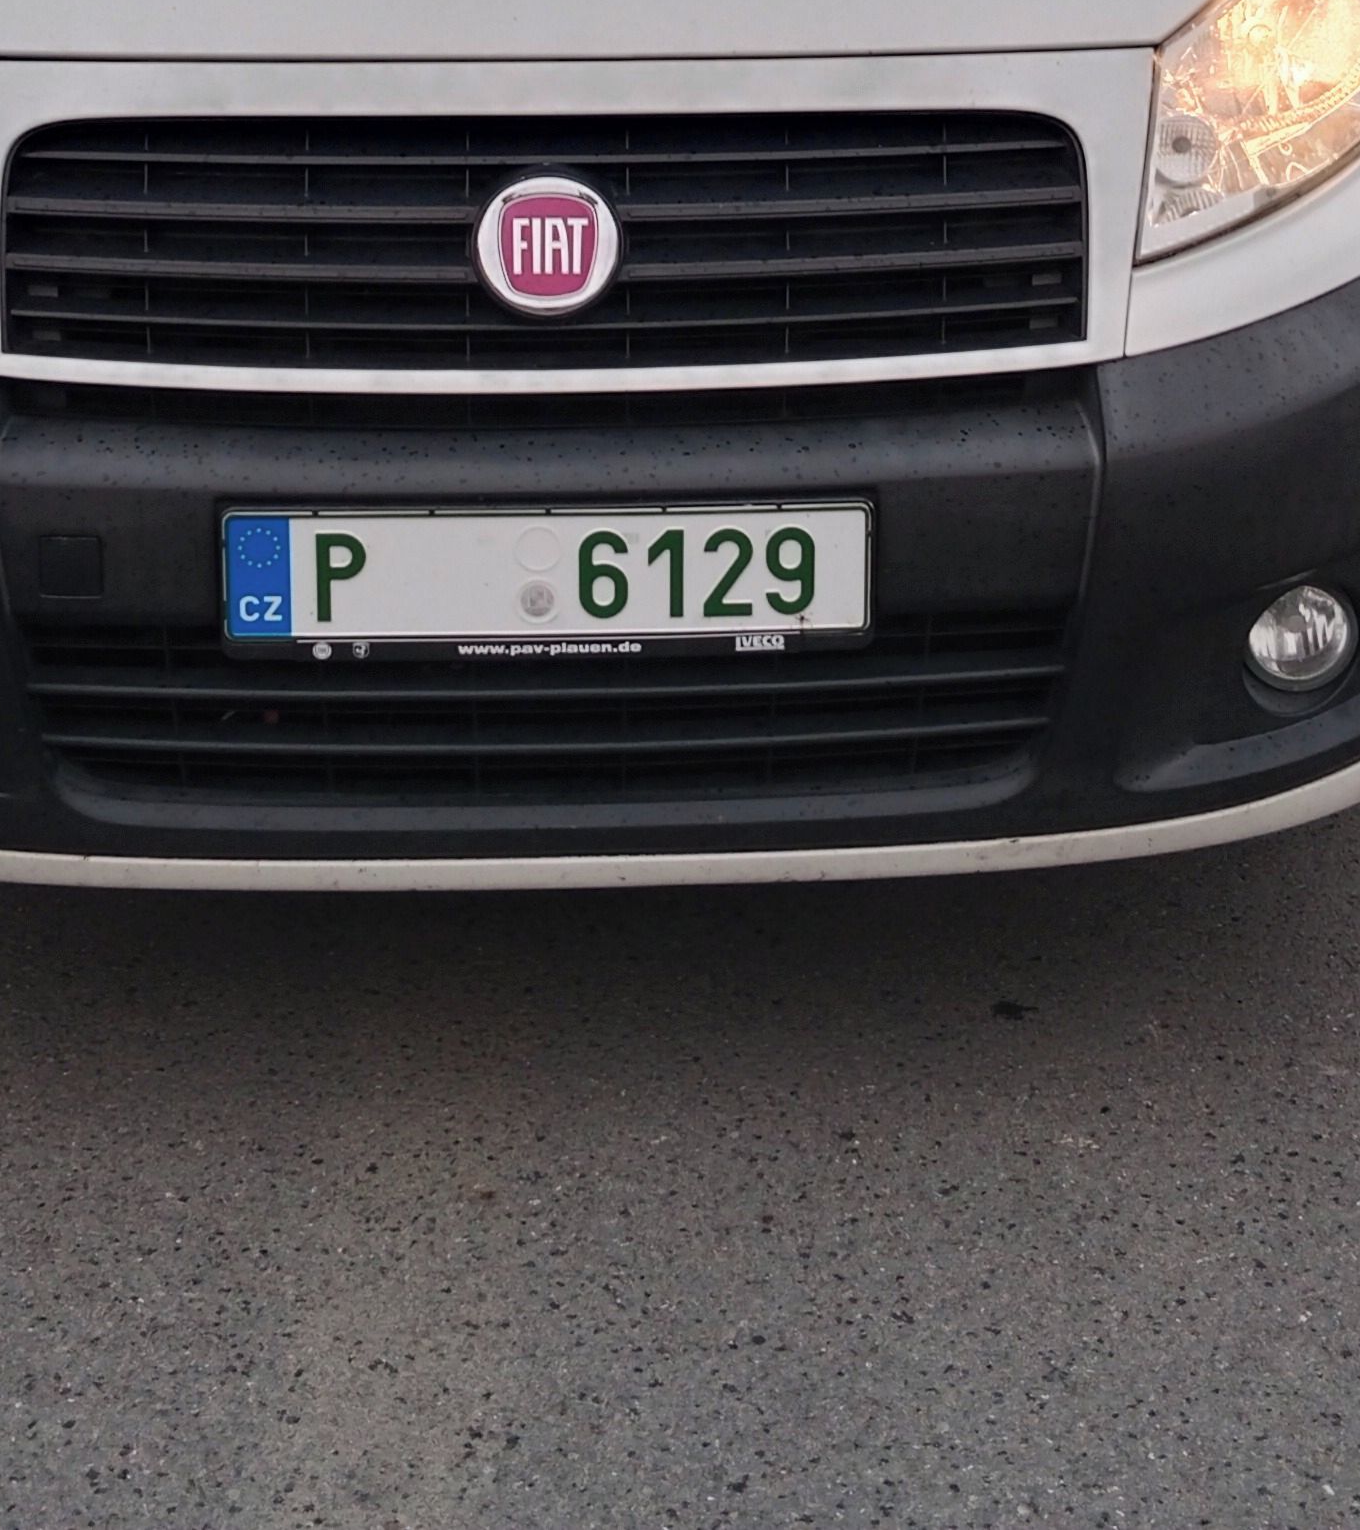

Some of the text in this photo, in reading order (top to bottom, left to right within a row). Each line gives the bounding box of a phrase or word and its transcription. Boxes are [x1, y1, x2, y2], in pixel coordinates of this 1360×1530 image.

[512, 217, 589, 275] FIAT
[314, 527, 816, 623] P 6129
[240, 595, 283, 622] CZ
[458, 642, 642, 656] www.pav-plauen.de
[735, 634, 785, 650] IVECO
